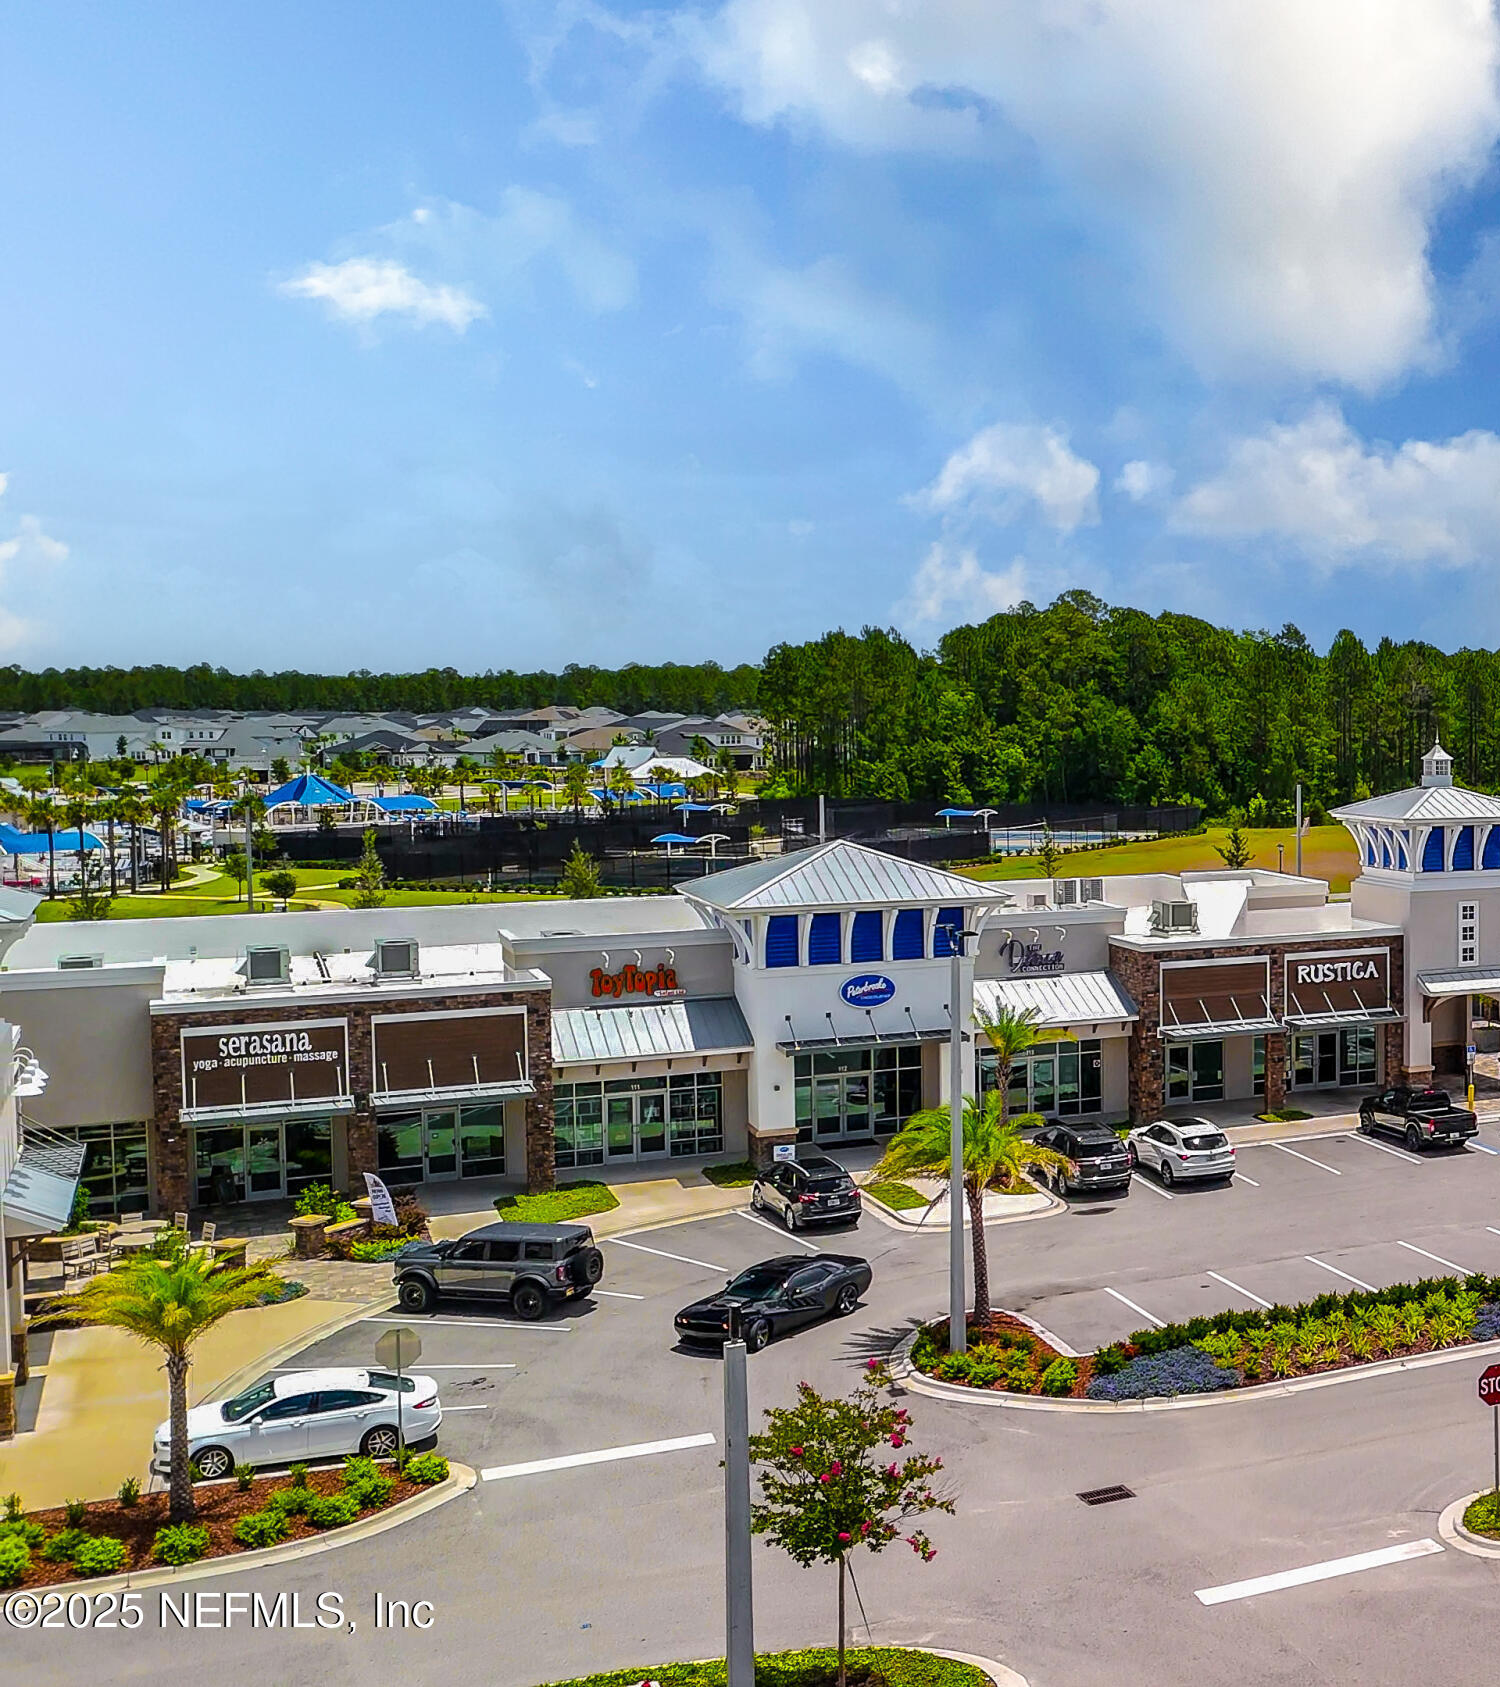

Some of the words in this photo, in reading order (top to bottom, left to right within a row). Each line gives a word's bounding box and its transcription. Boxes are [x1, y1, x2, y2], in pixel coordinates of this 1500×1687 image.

[589, 962, 678, 998] ToyTopia
[1297, 960, 1379, 984] RUSTICA
[218, 1031, 313, 1057] serasana
[193, 1058, 218, 1072] yoga
[223, 1052, 288, 1068] acupuncture
[293, 1050, 339, 1062] massage
